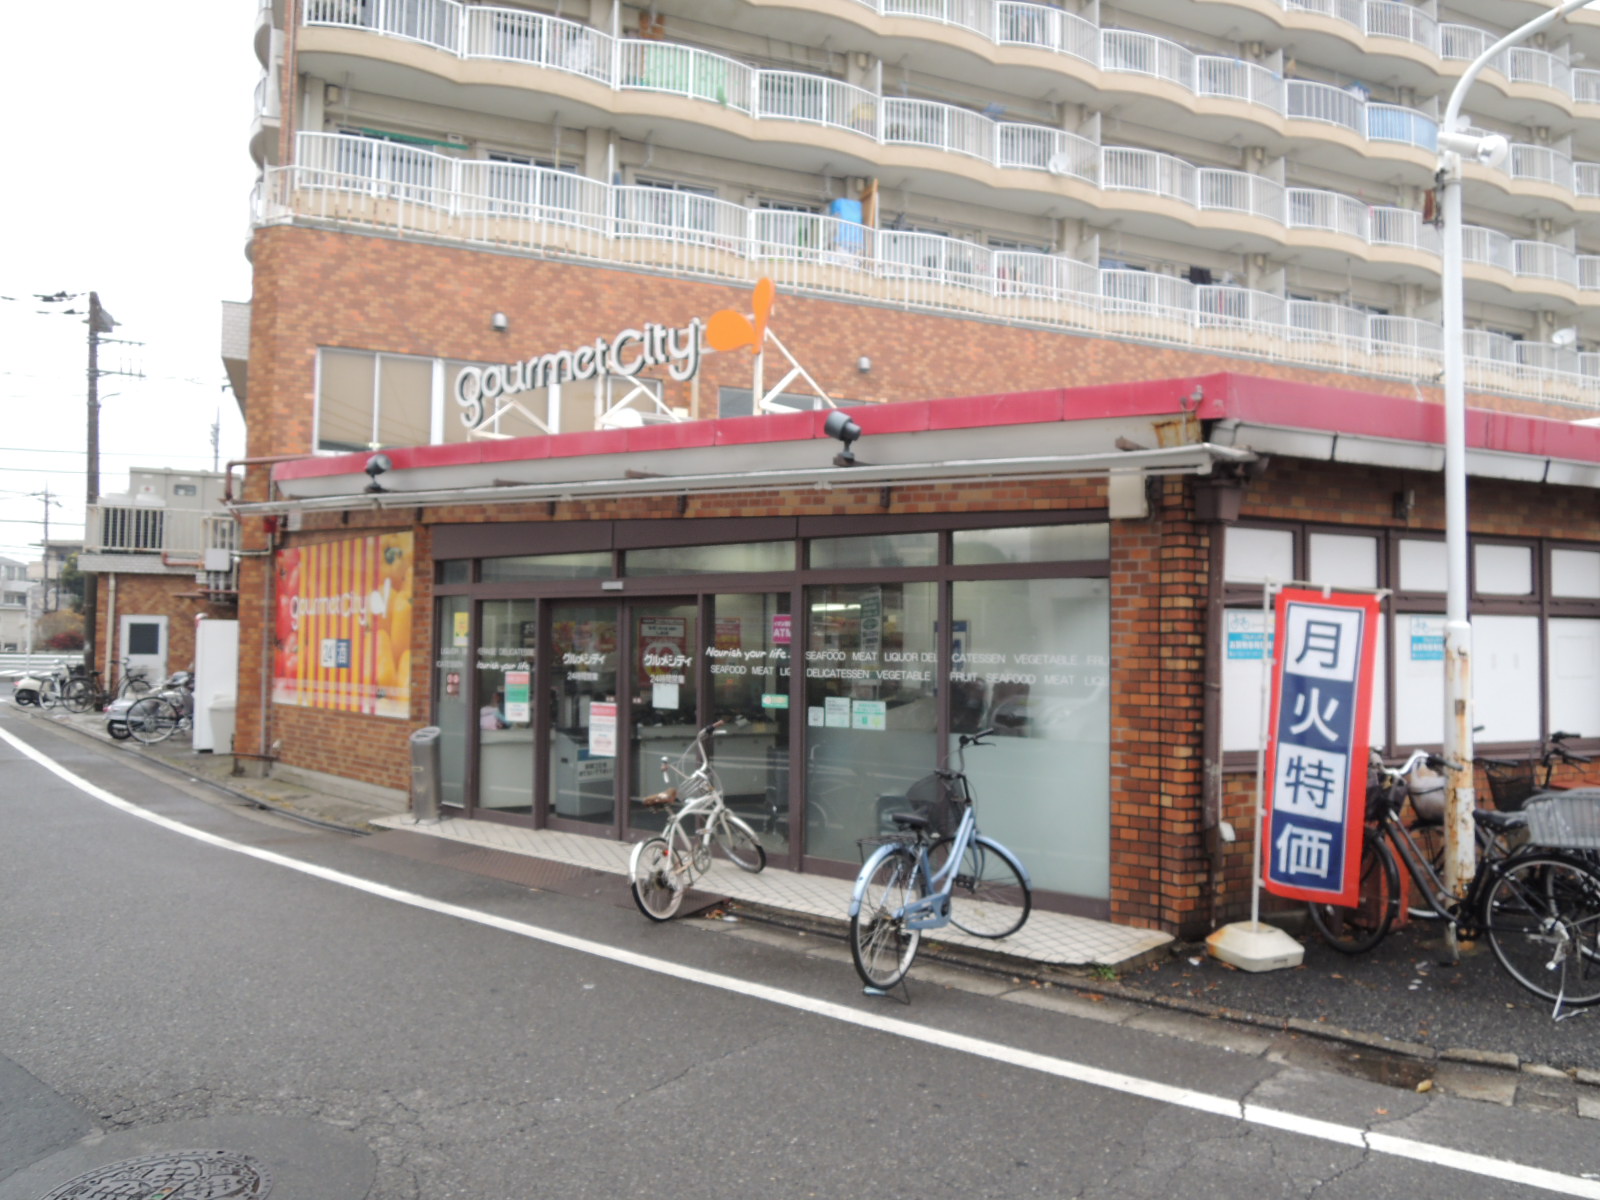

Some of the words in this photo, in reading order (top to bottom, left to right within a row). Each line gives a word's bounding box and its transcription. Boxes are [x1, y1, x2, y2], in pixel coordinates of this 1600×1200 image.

[454, 316, 703, 428] gourmetCity
[562, 652, 606, 665] グルメシティ
[705, 646, 742, 658] Nourish
[744, 649, 767, 661] your
[805, 650, 846, 661] SEAFOOD
[851, 652, 877, 662] MEAT
[884, 652, 918, 662] LIQUOR
[1013, 654, 1077, 666] VEGETABLE
[644, 654, 693, 667] グルメシティ
[710, 664, 747, 675] SEAFOOD
[751, 665, 774, 676] MEAT
[806, 668, 870, 679] DELICATESSEN
[875, 671, 931, 681] VEGETABLE
[949, 671, 978, 682] FRUIT
[985, 673, 1037, 684] SEAFOOD
[1044, 674, 1074, 685] MEAT
[1276, 619, 1343, 879] 月火特価
